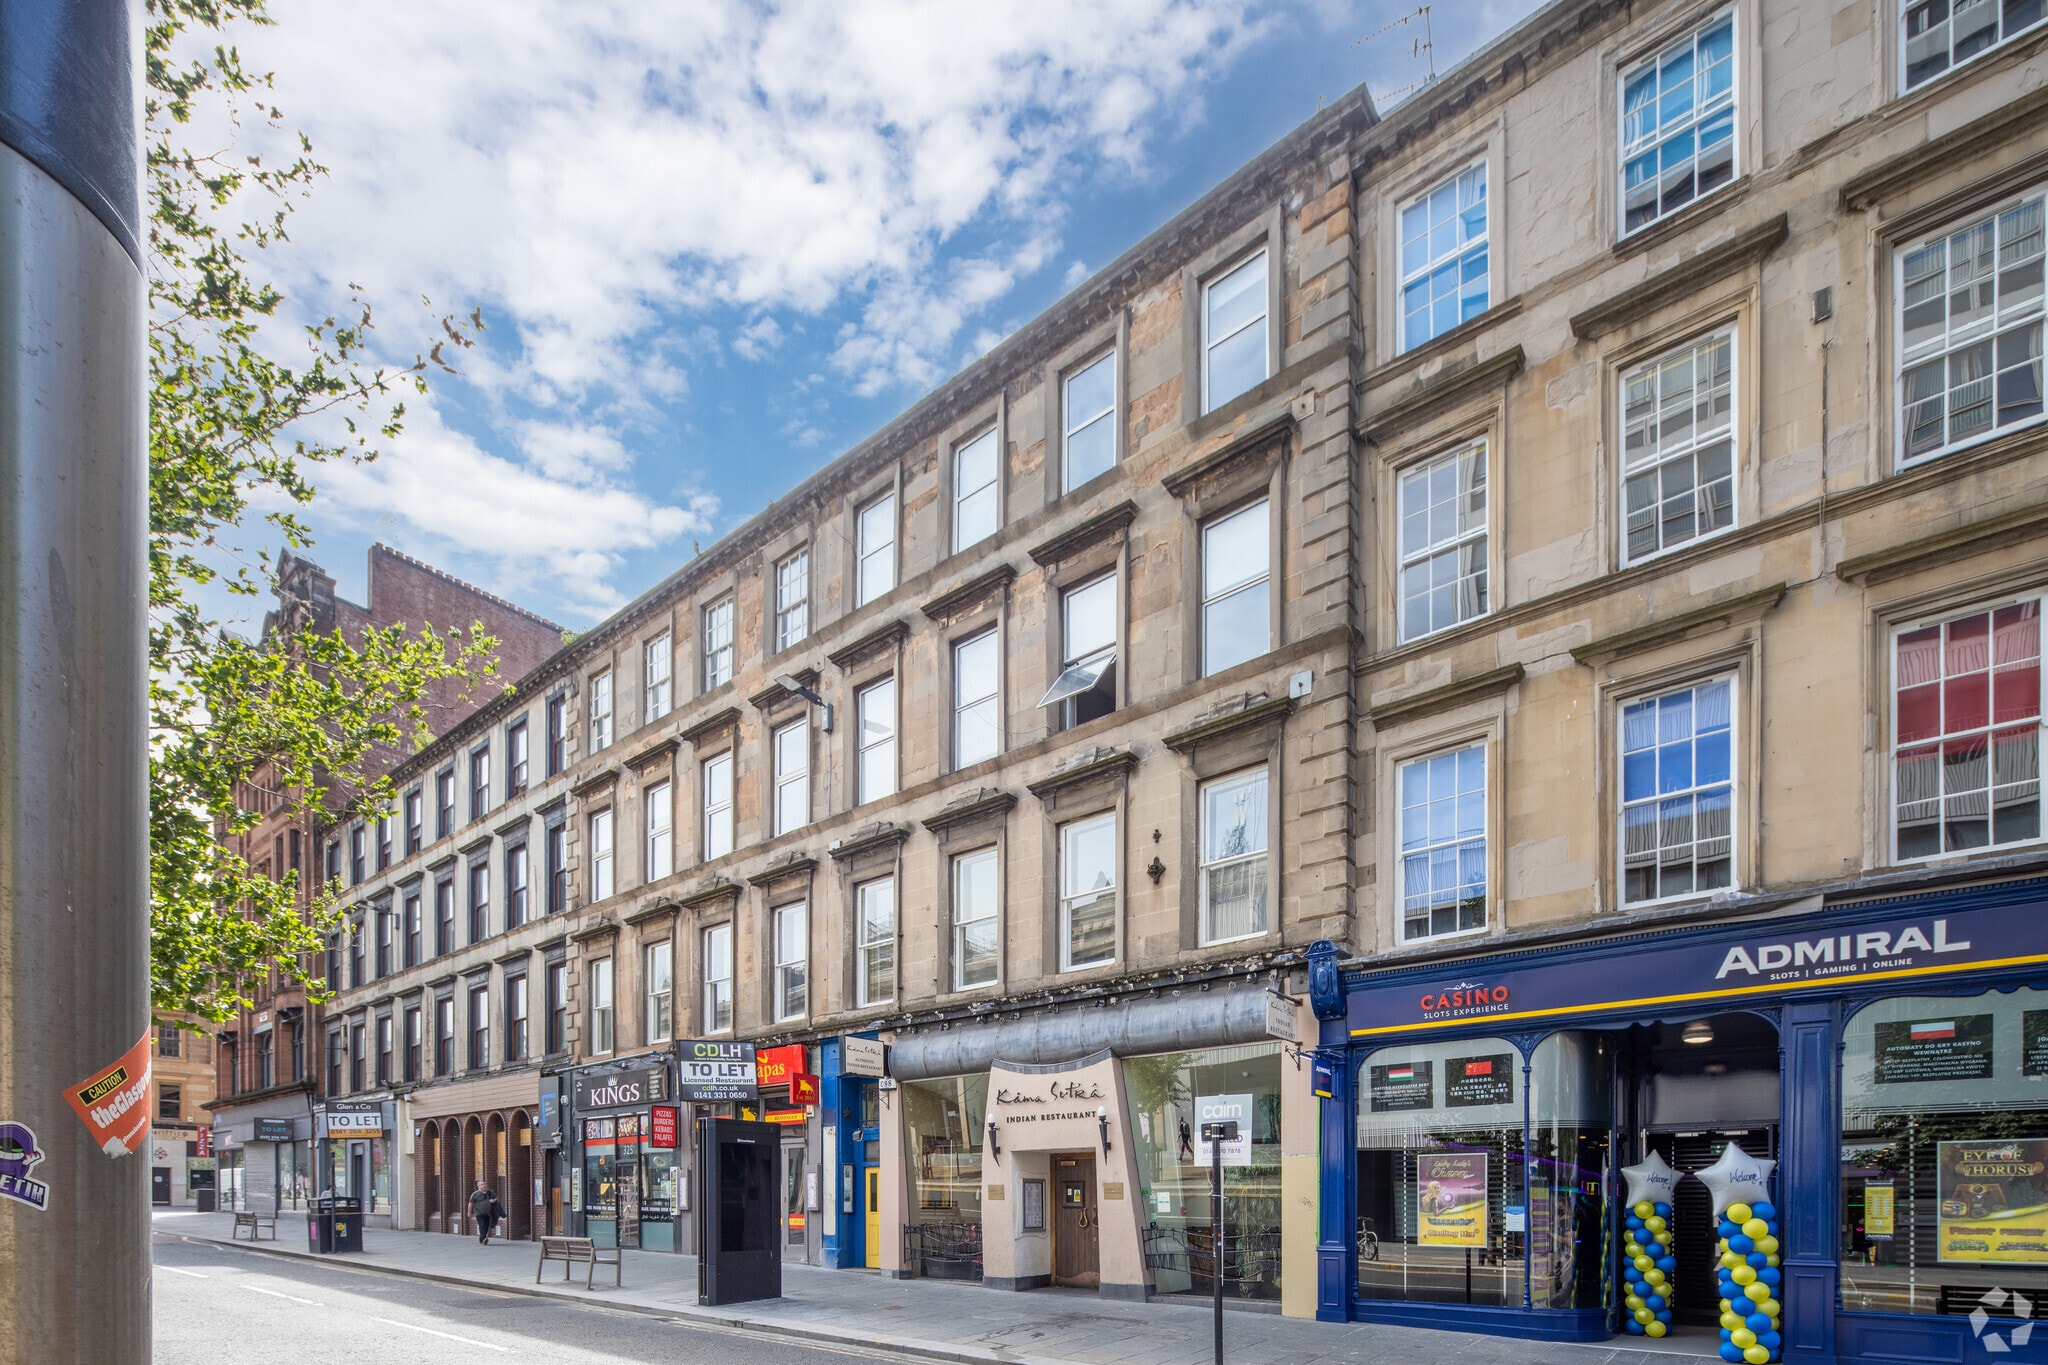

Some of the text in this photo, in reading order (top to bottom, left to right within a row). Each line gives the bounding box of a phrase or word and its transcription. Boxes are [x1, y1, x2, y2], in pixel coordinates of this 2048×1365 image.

[1714, 919, 1970, 979] ADMIRAL
[1770, 958, 1912, 981] SLOTS GAMING ONLINE
[1421, 986, 1509, 1010] CASINO
[1424, 1004, 1509, 1019] SLOTS EXPERIENCE
[694, 1043, 741, 1058] CDLH
[1886, 1044, 1923, 1052] AUTOMATY
[688, 1063, 748, 1077] TO LET
[88, 1072, 122, 1099] CAUTION
[702, 1084, 738, 1092] cdlh.co.uk
[590, 1083, 640, 1106] KINGS
[1202, 1100, 1242, 1118] cairn
[329, 1116, 380, 1126] TO LET
[1006, 1111, 1096, 1123] INDIAN RESTAURANT
[623, 1145, 634, 1155] 325
[1730, 1165, 1763, 1187] Welcome!
[1973, 1165, 2027, 1175] HORUS
[1647, 1171, 1673, 1191] Welcome!
